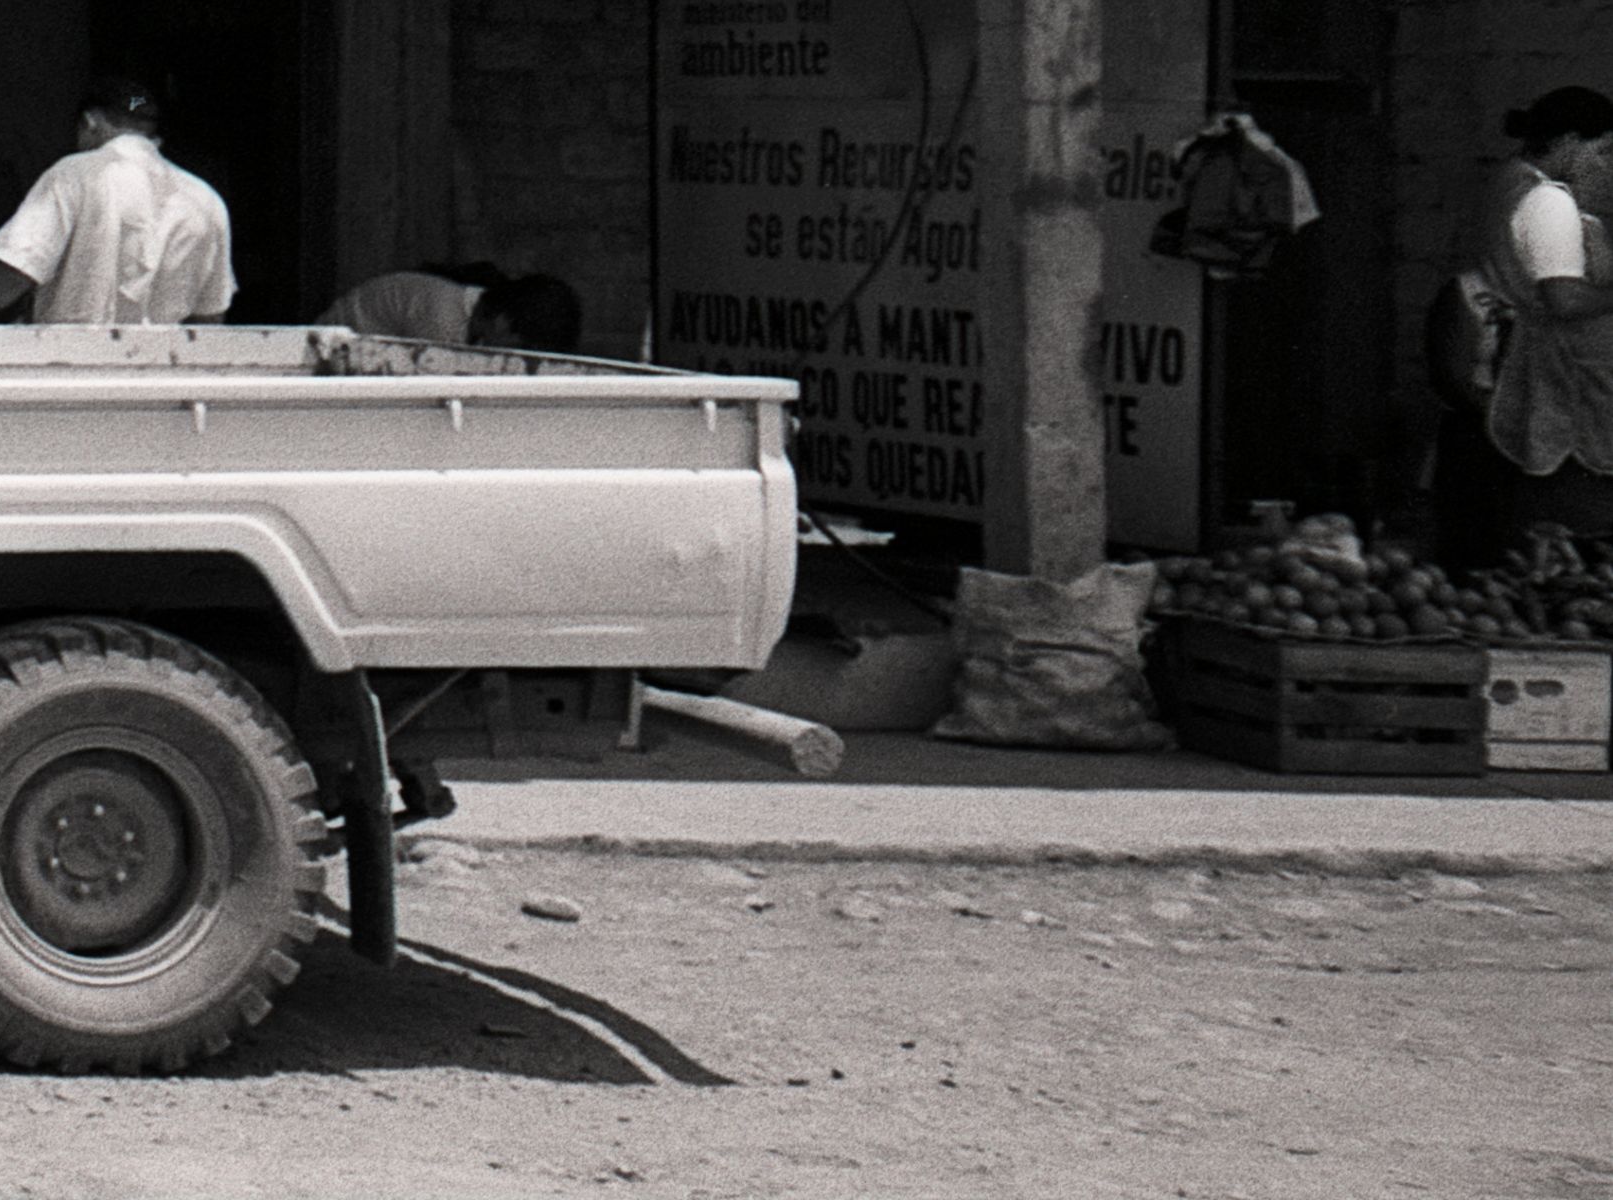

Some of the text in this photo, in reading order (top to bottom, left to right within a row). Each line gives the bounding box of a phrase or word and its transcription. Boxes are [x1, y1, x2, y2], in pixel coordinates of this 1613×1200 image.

[680, 28, 832, 79] ambiente
[668, 125, 804, 189] Nuestros
[819, 126, 977, 194] Recursos
[745, 210, 784, 259] se
[668, 291, 829, 355] AYUDANOS
[843, 308, 865, 358] A
[853, 372, 910, 432] QUE
